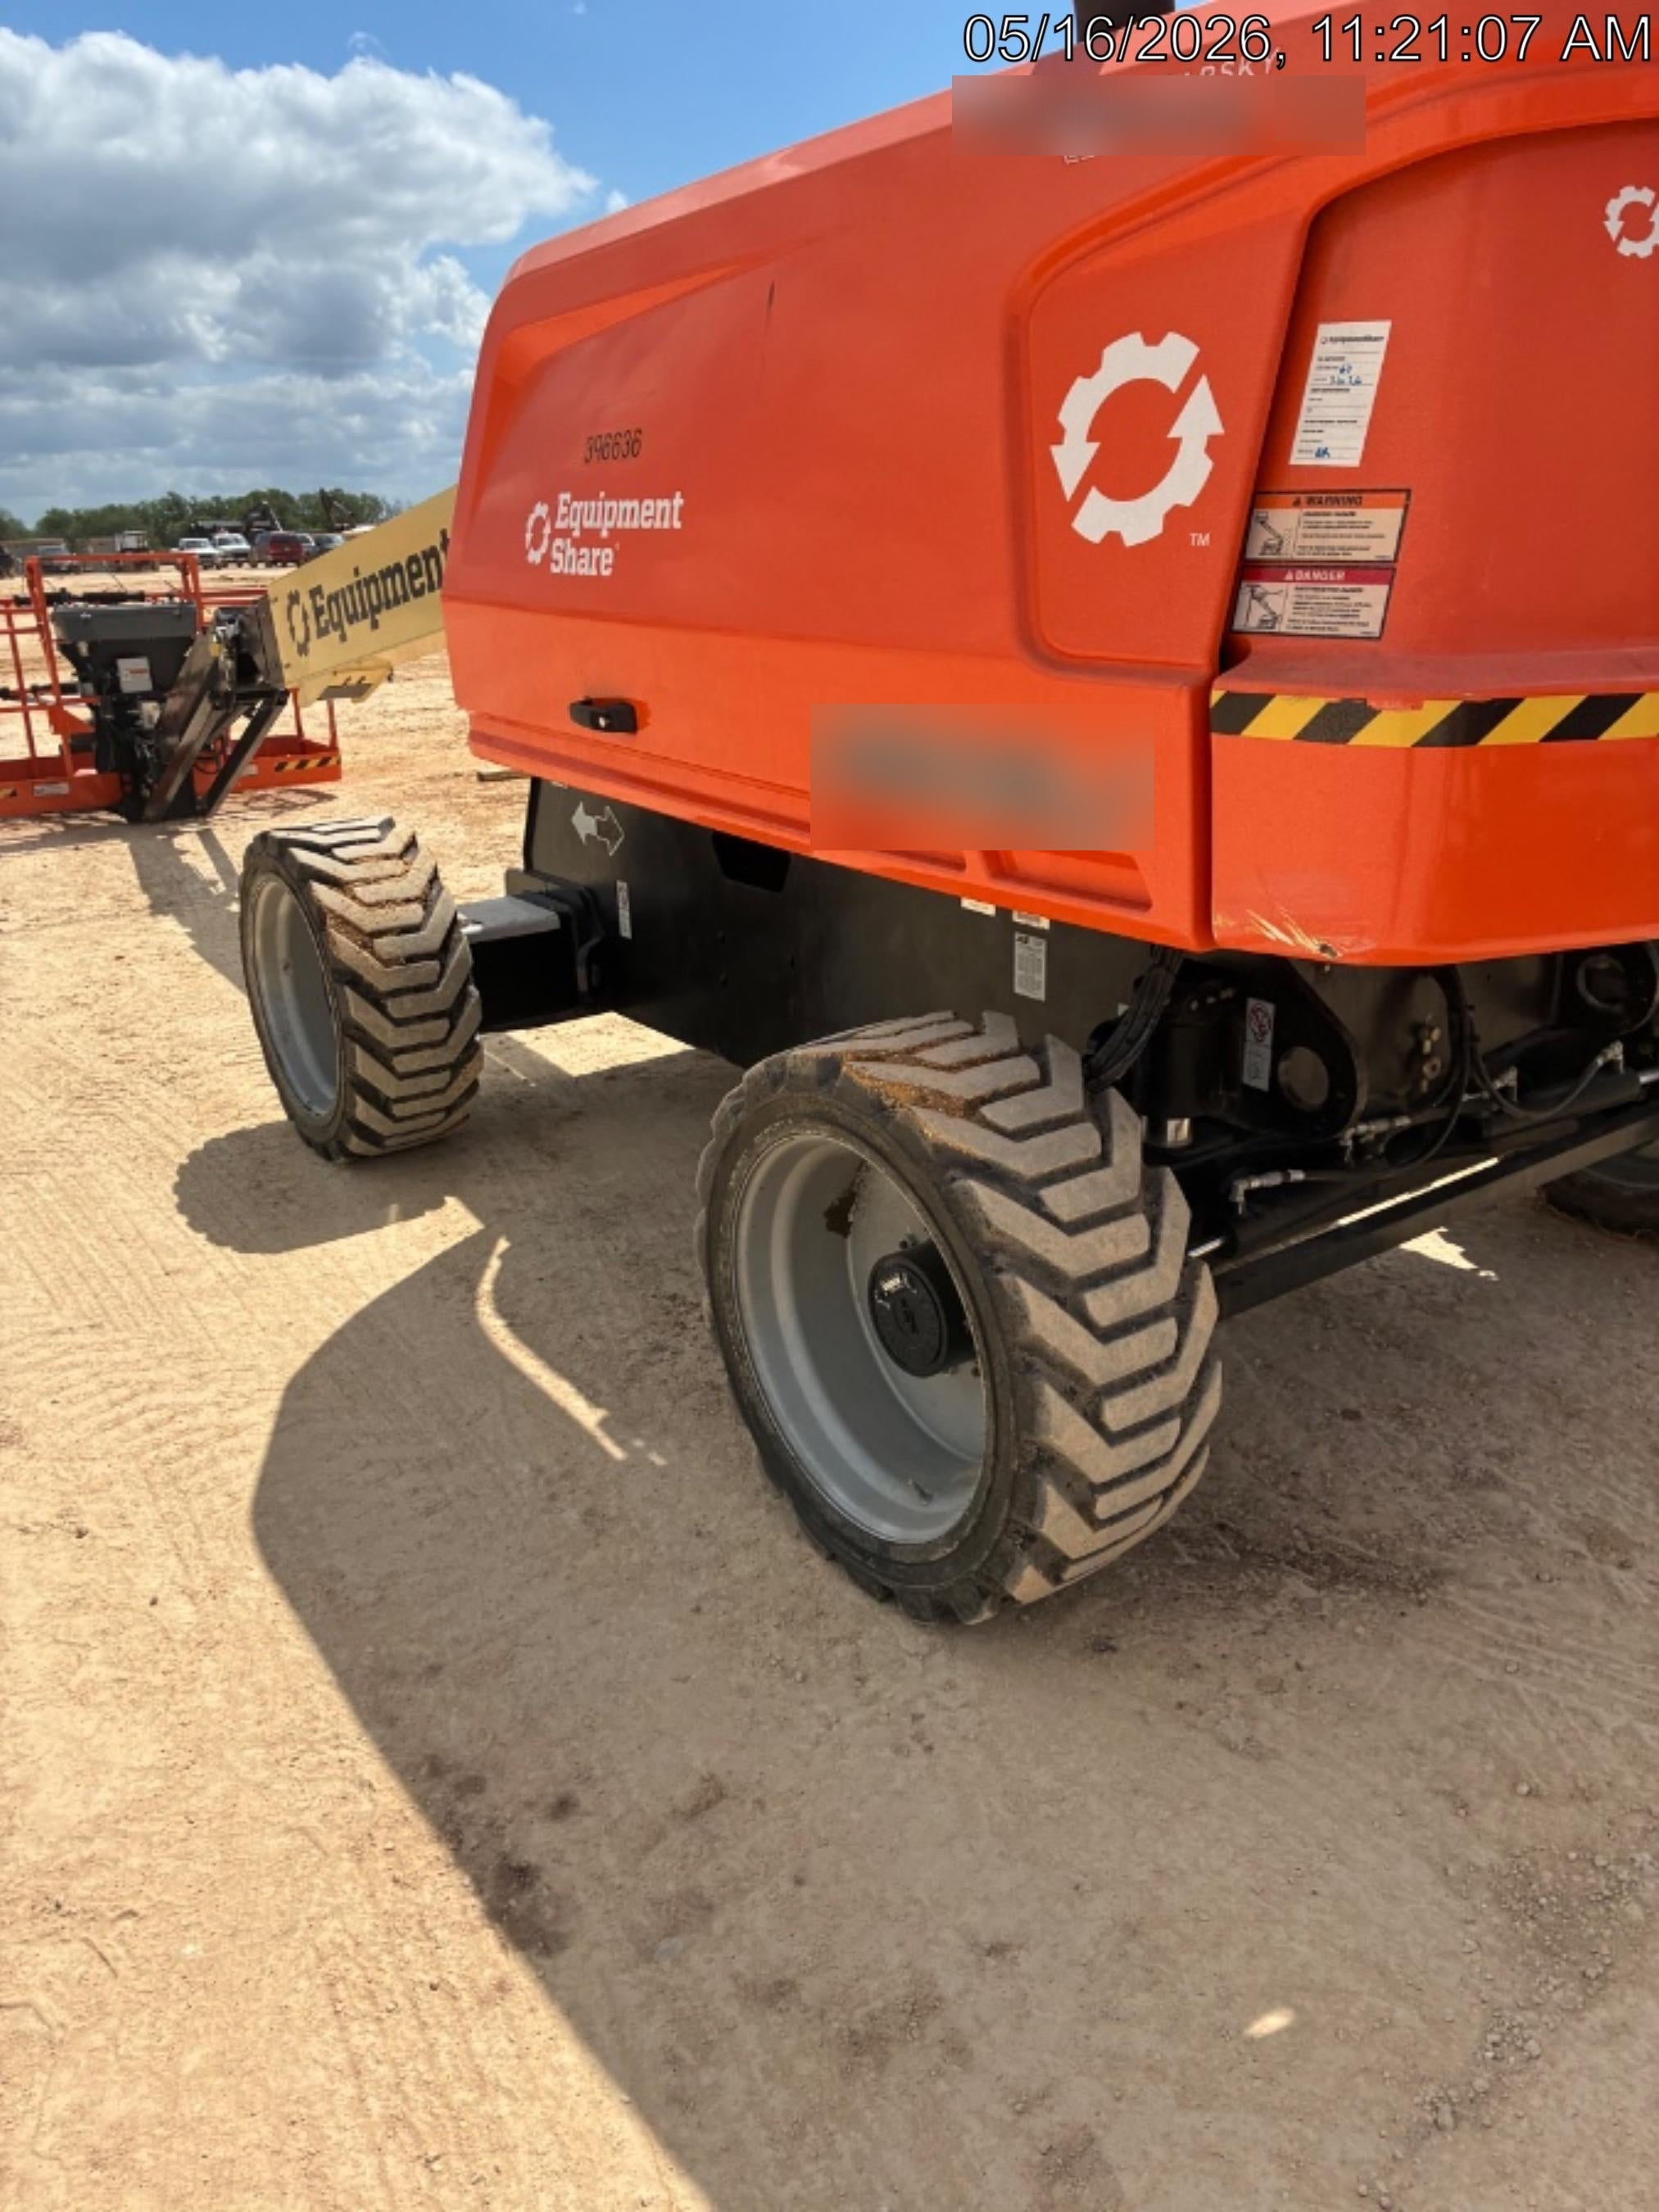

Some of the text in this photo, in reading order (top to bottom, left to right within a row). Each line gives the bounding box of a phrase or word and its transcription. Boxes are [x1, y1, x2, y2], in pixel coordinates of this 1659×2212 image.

[583, 428, 642, 465] 396636
[555, 491, 684, 537] Equipment
[550, 537, 614, 576] Share
[1190, 532, 1210, 546] TM
[1294, 570, 1346, 581] DANGER
